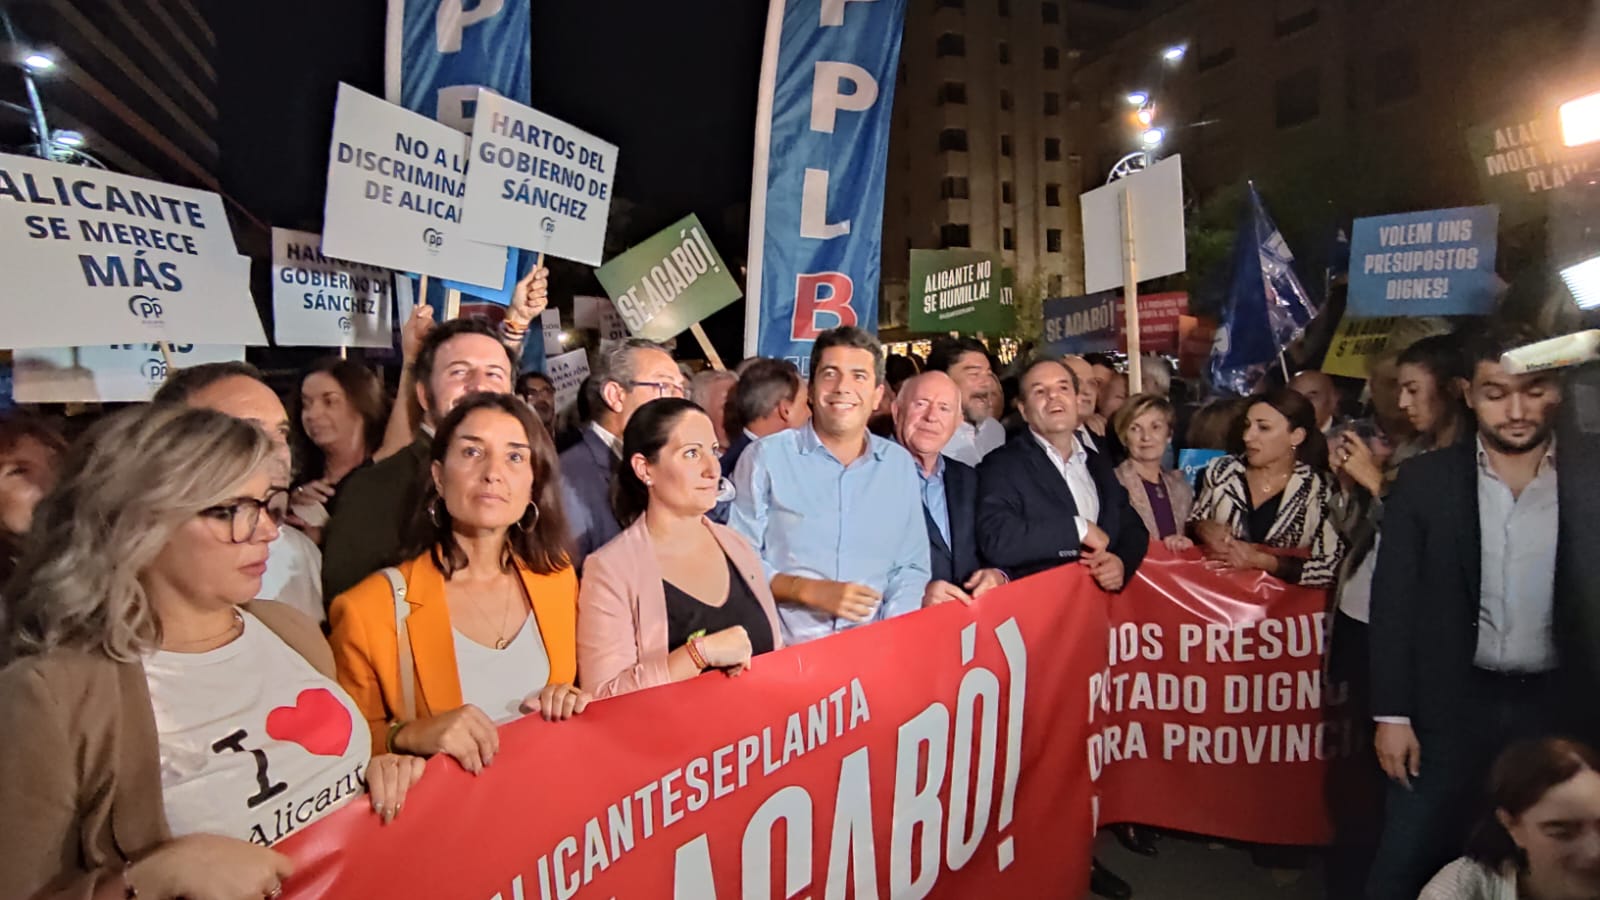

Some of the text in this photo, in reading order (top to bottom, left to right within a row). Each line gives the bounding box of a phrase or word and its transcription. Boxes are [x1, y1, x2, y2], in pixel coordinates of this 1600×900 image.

[395, 132, 428, 159] NO
[434, 148, 447, 168] A
[491, 112, 606, 174] HARTOS DEL
[1485, 146, 1537, 176] MOLT
[337, 142, 466, 198] DISCRIMINA
[478, 142, 607, 201] GOBIERNO DE
[0, 169, 206, 229] ALICANTE
[364, 180, 463, 224] DE ALICA
[501, 177, 588, 221] SÁNCHEZ
[25, 215, 198, 255] SE MERECE
[1379, 219, 1473, 247] VOLEM UNS
[78, 250, 183, 292] MÁS
[925, 260, 991, 293] ALICANTE NO
[1364, 247, 1478, 274] PRESUPOSTOS
[280, 268, 369, 293] GOBIERNO
[373, 280, 388, 295] DE
[924, 293, 937, 314] SE
[940, 280, 990, 310] HUMILLA!
[1386, 277, 1449, 300] DIGNES!
[303, 290, 375, 315] SÁNCHEZ
[1046, 317, 1063, 342] SE
[212, 729, 288, 808] I
[489, 677, 870, 900] ICANTESEPLANTA
